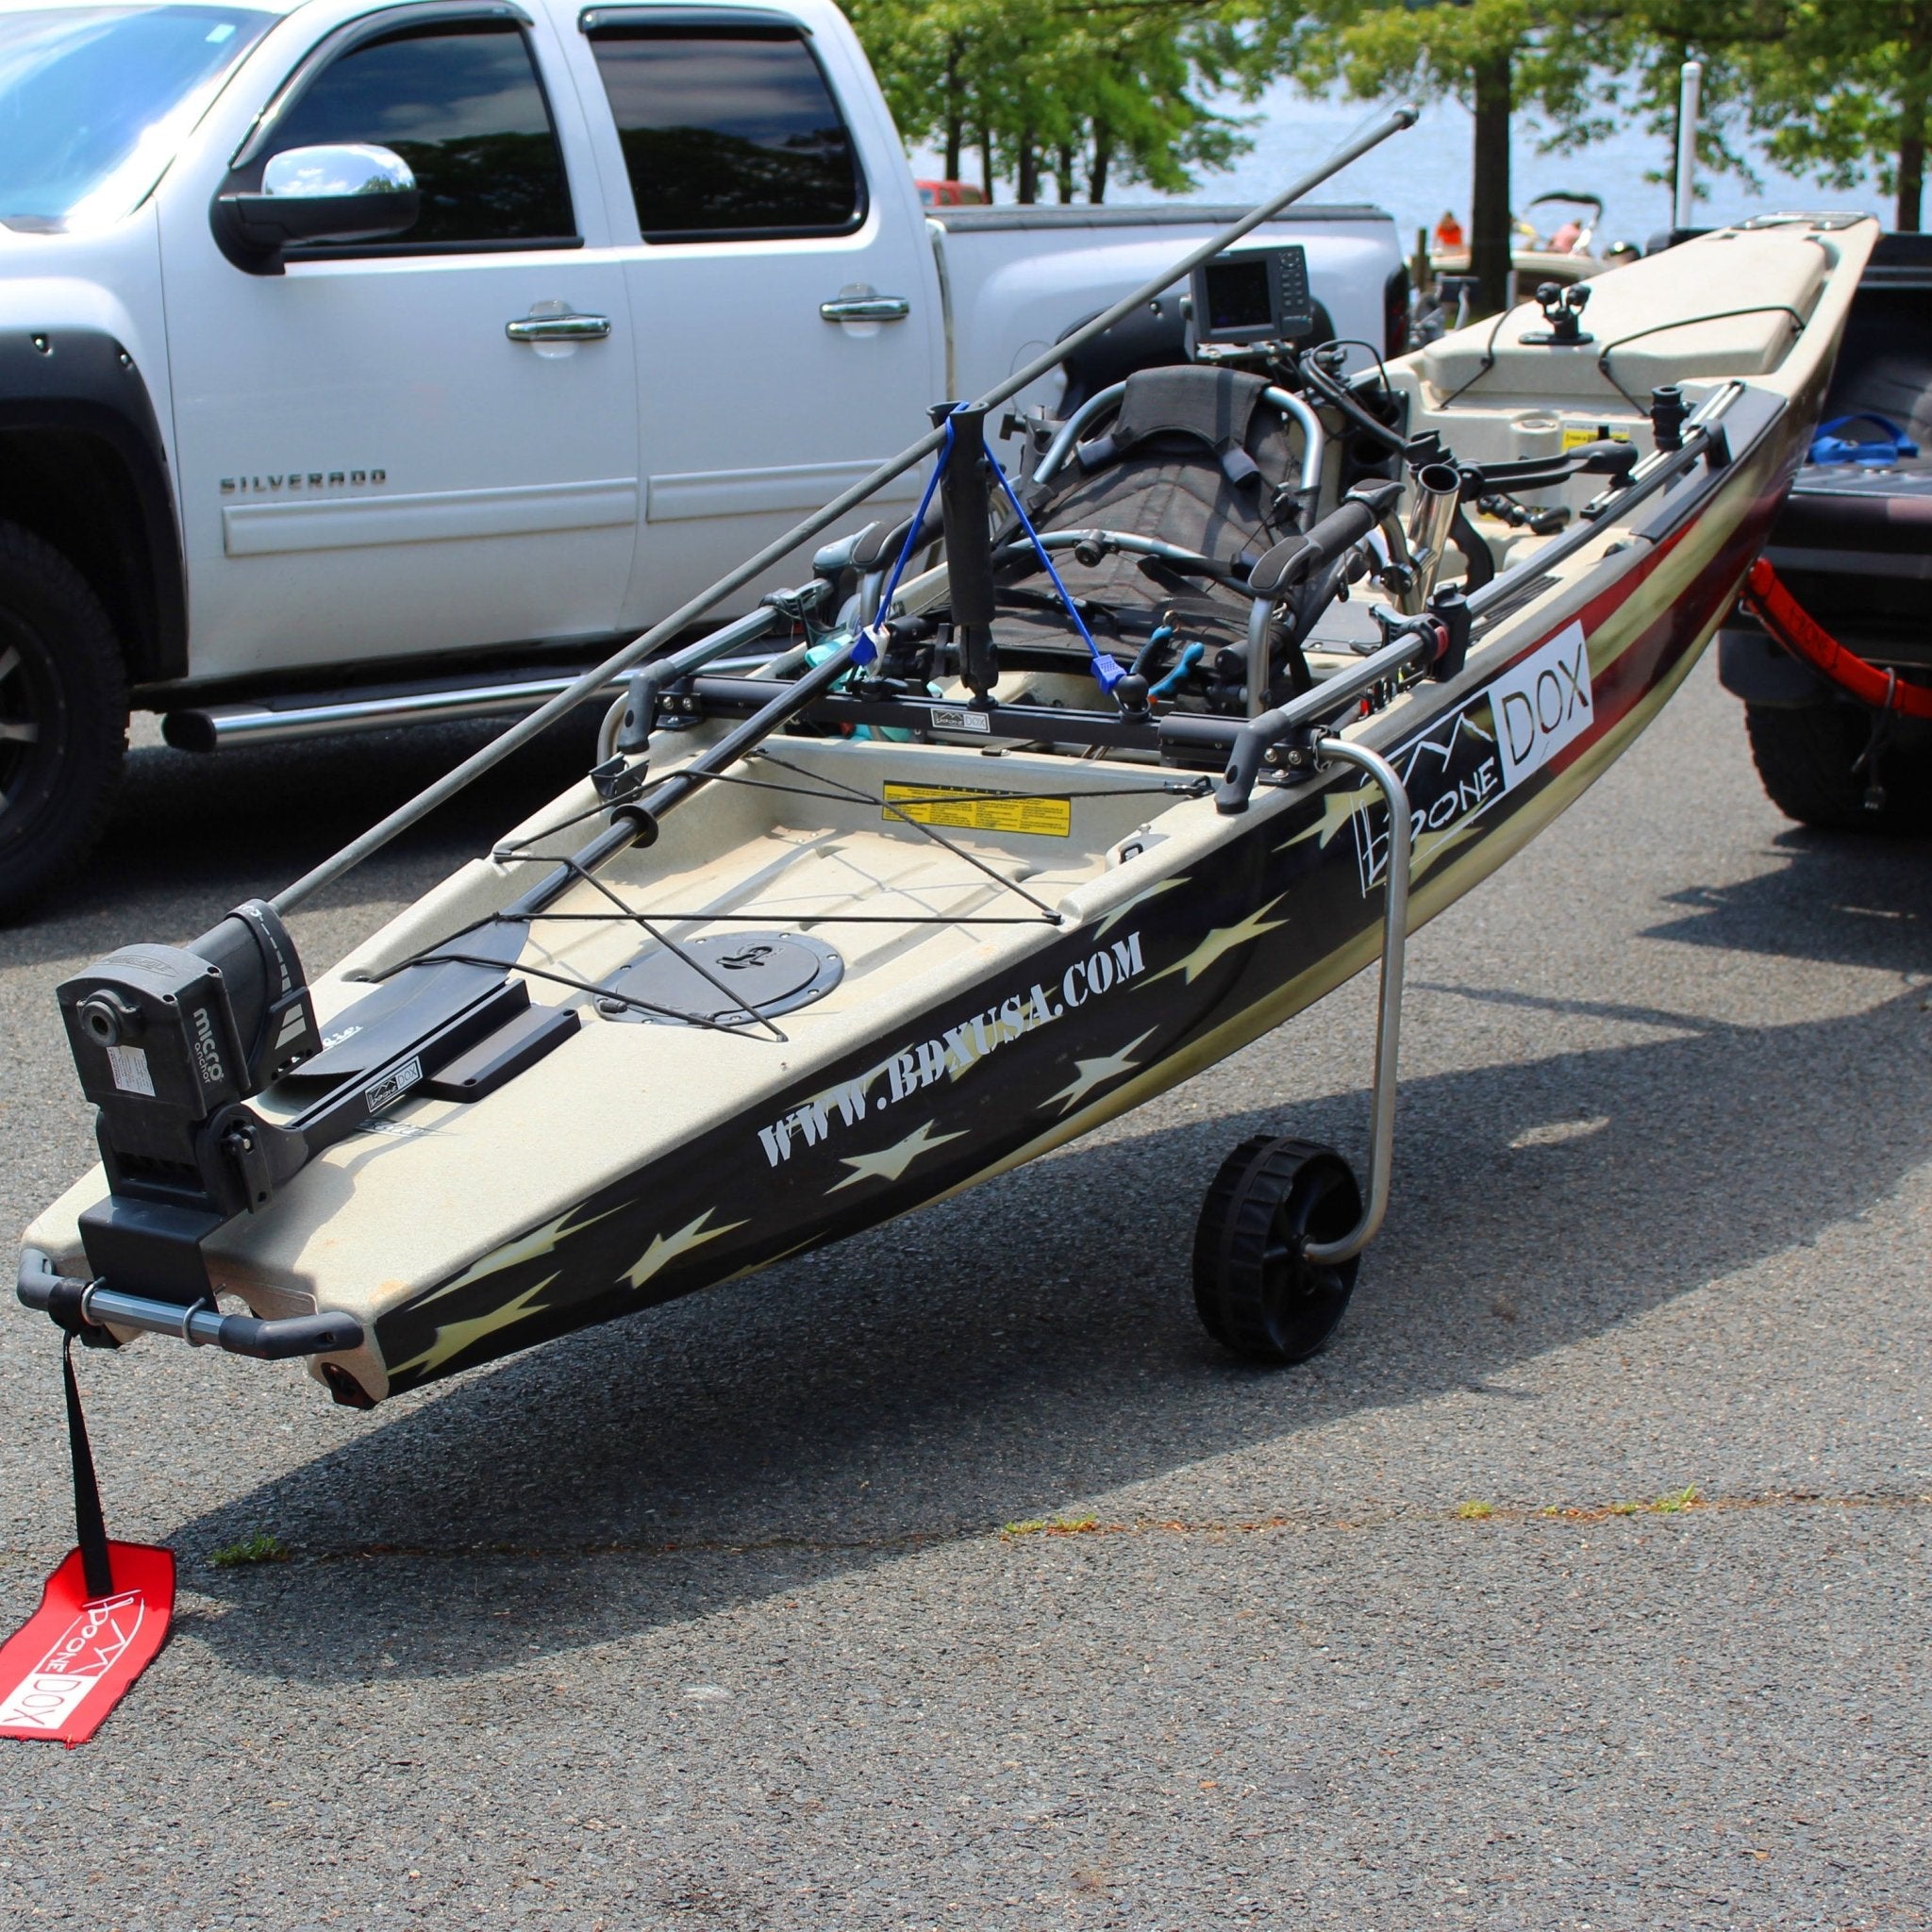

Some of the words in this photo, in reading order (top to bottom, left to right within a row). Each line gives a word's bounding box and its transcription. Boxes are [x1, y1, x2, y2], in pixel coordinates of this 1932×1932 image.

[220, 469, 386, 493] SILVERADO
[1502, 643, 1589, 765] DOX
[193, 1008, 223, 1081] micro
[194, 1042, 210, 1083] anchor
[758, 931, 1145, 1168] WWW.BDXUSA.COM
[398, 1066, 417, 1086] DOX
[3, 1679, 81, 1724] DOX
